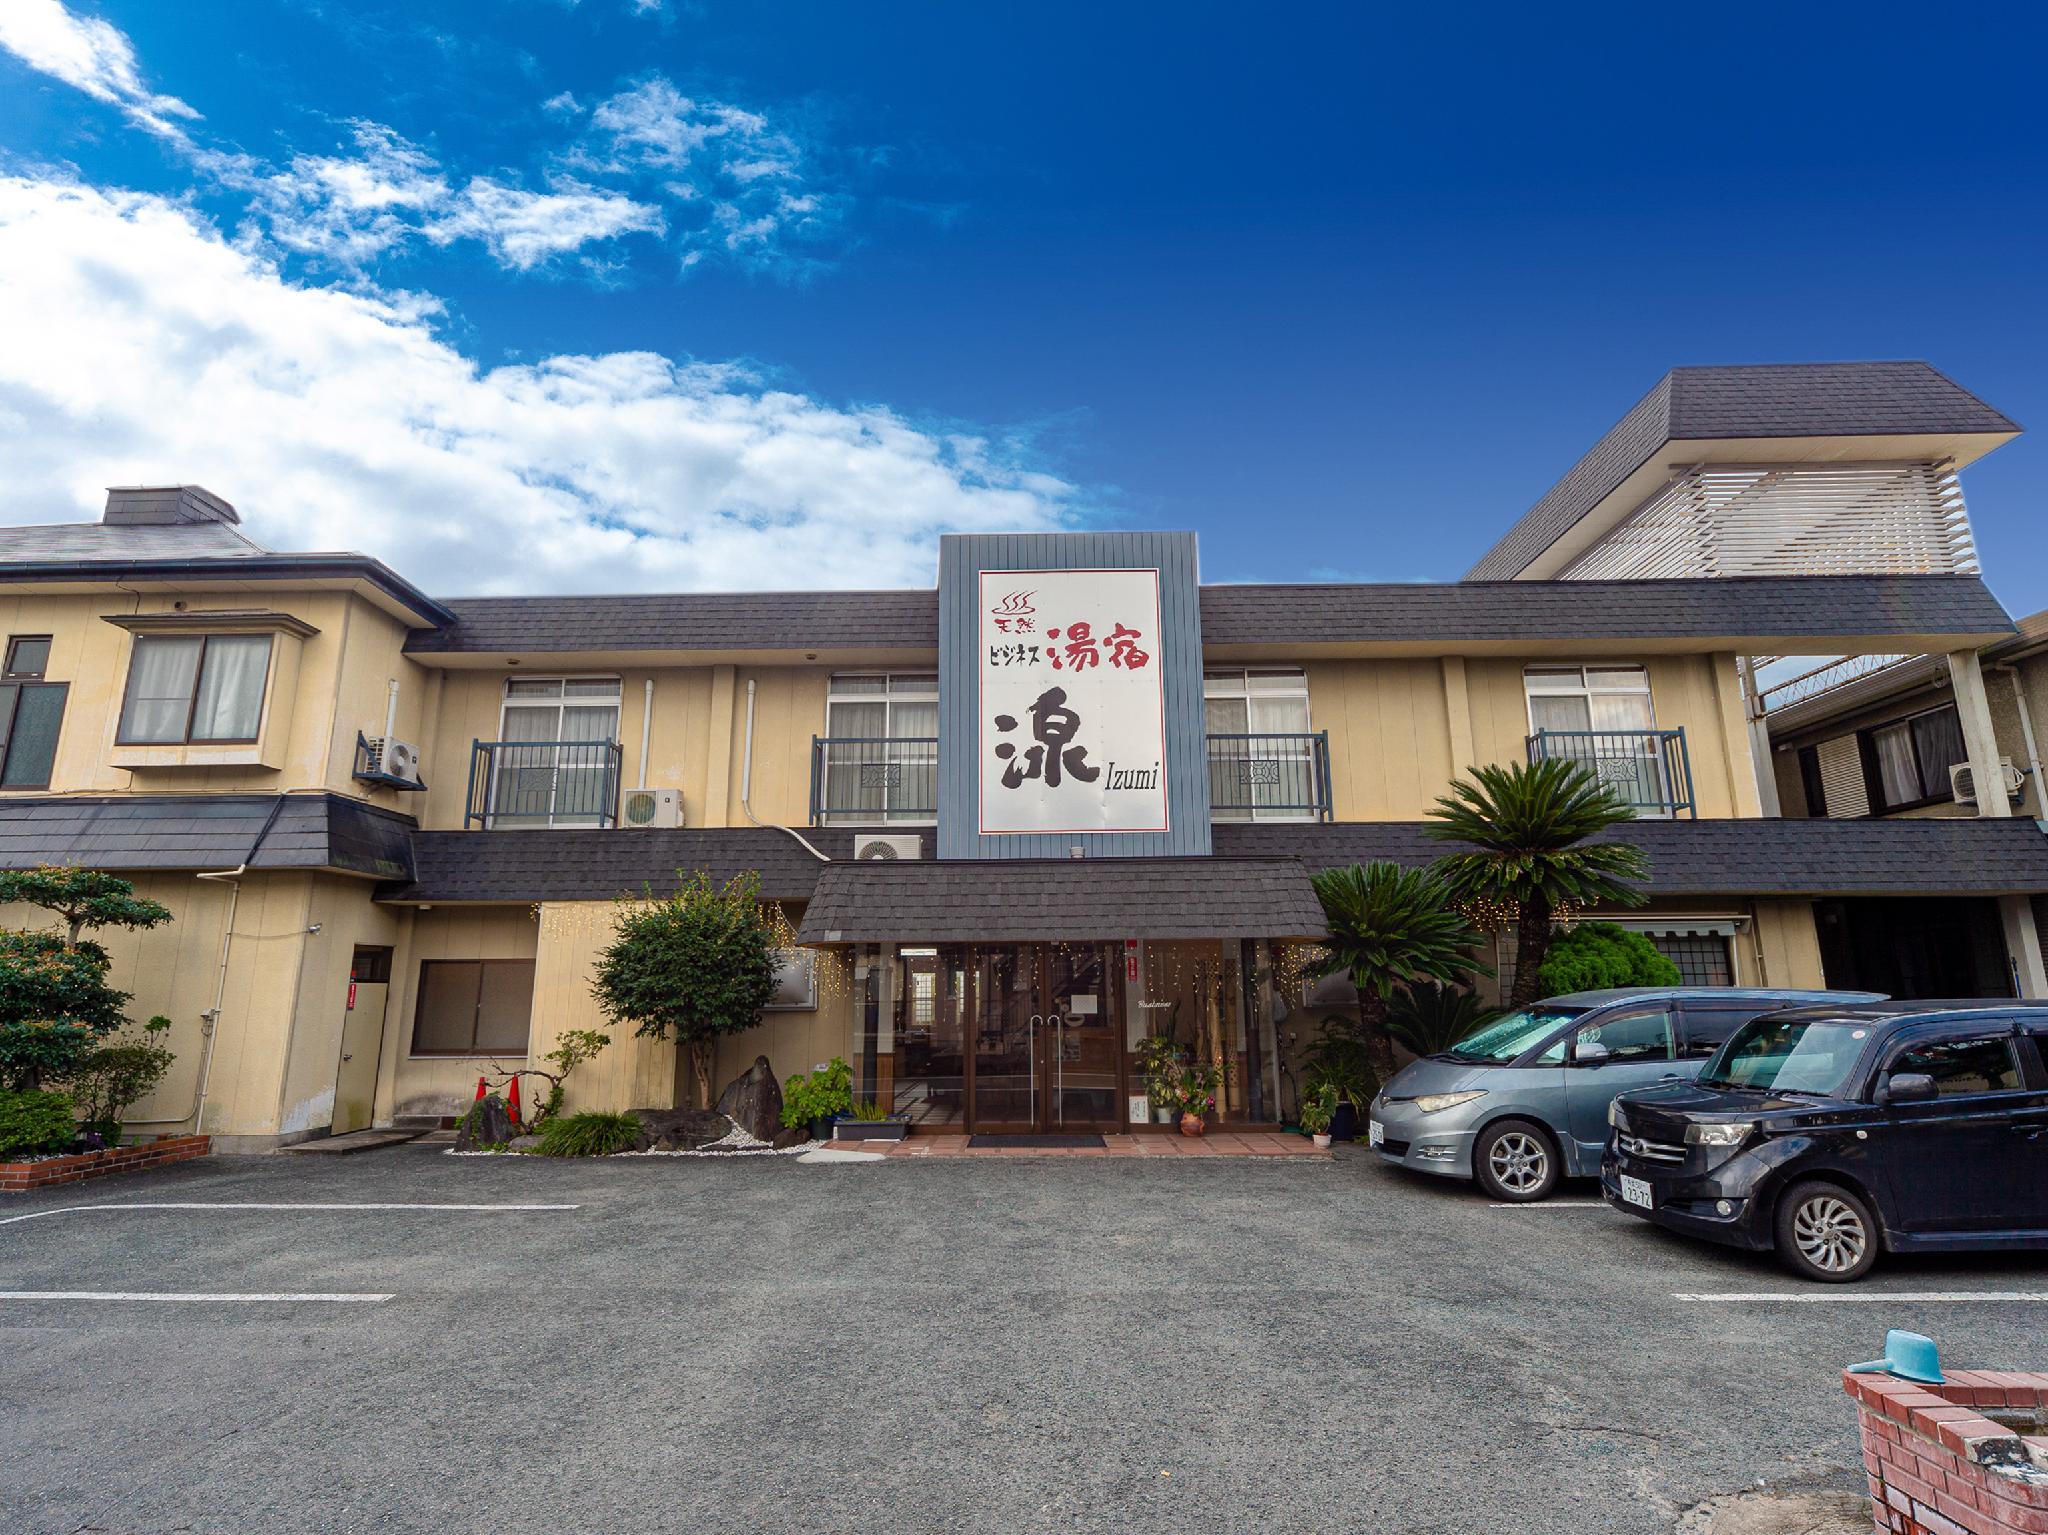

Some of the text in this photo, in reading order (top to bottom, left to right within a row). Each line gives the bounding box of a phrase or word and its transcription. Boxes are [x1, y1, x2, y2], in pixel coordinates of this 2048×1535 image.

[994, 618, 1036, 634] 天然
[990, 622, 1150, 672] ビジネス 湯宿
[1105, 761, 1160, 790] Izumi
